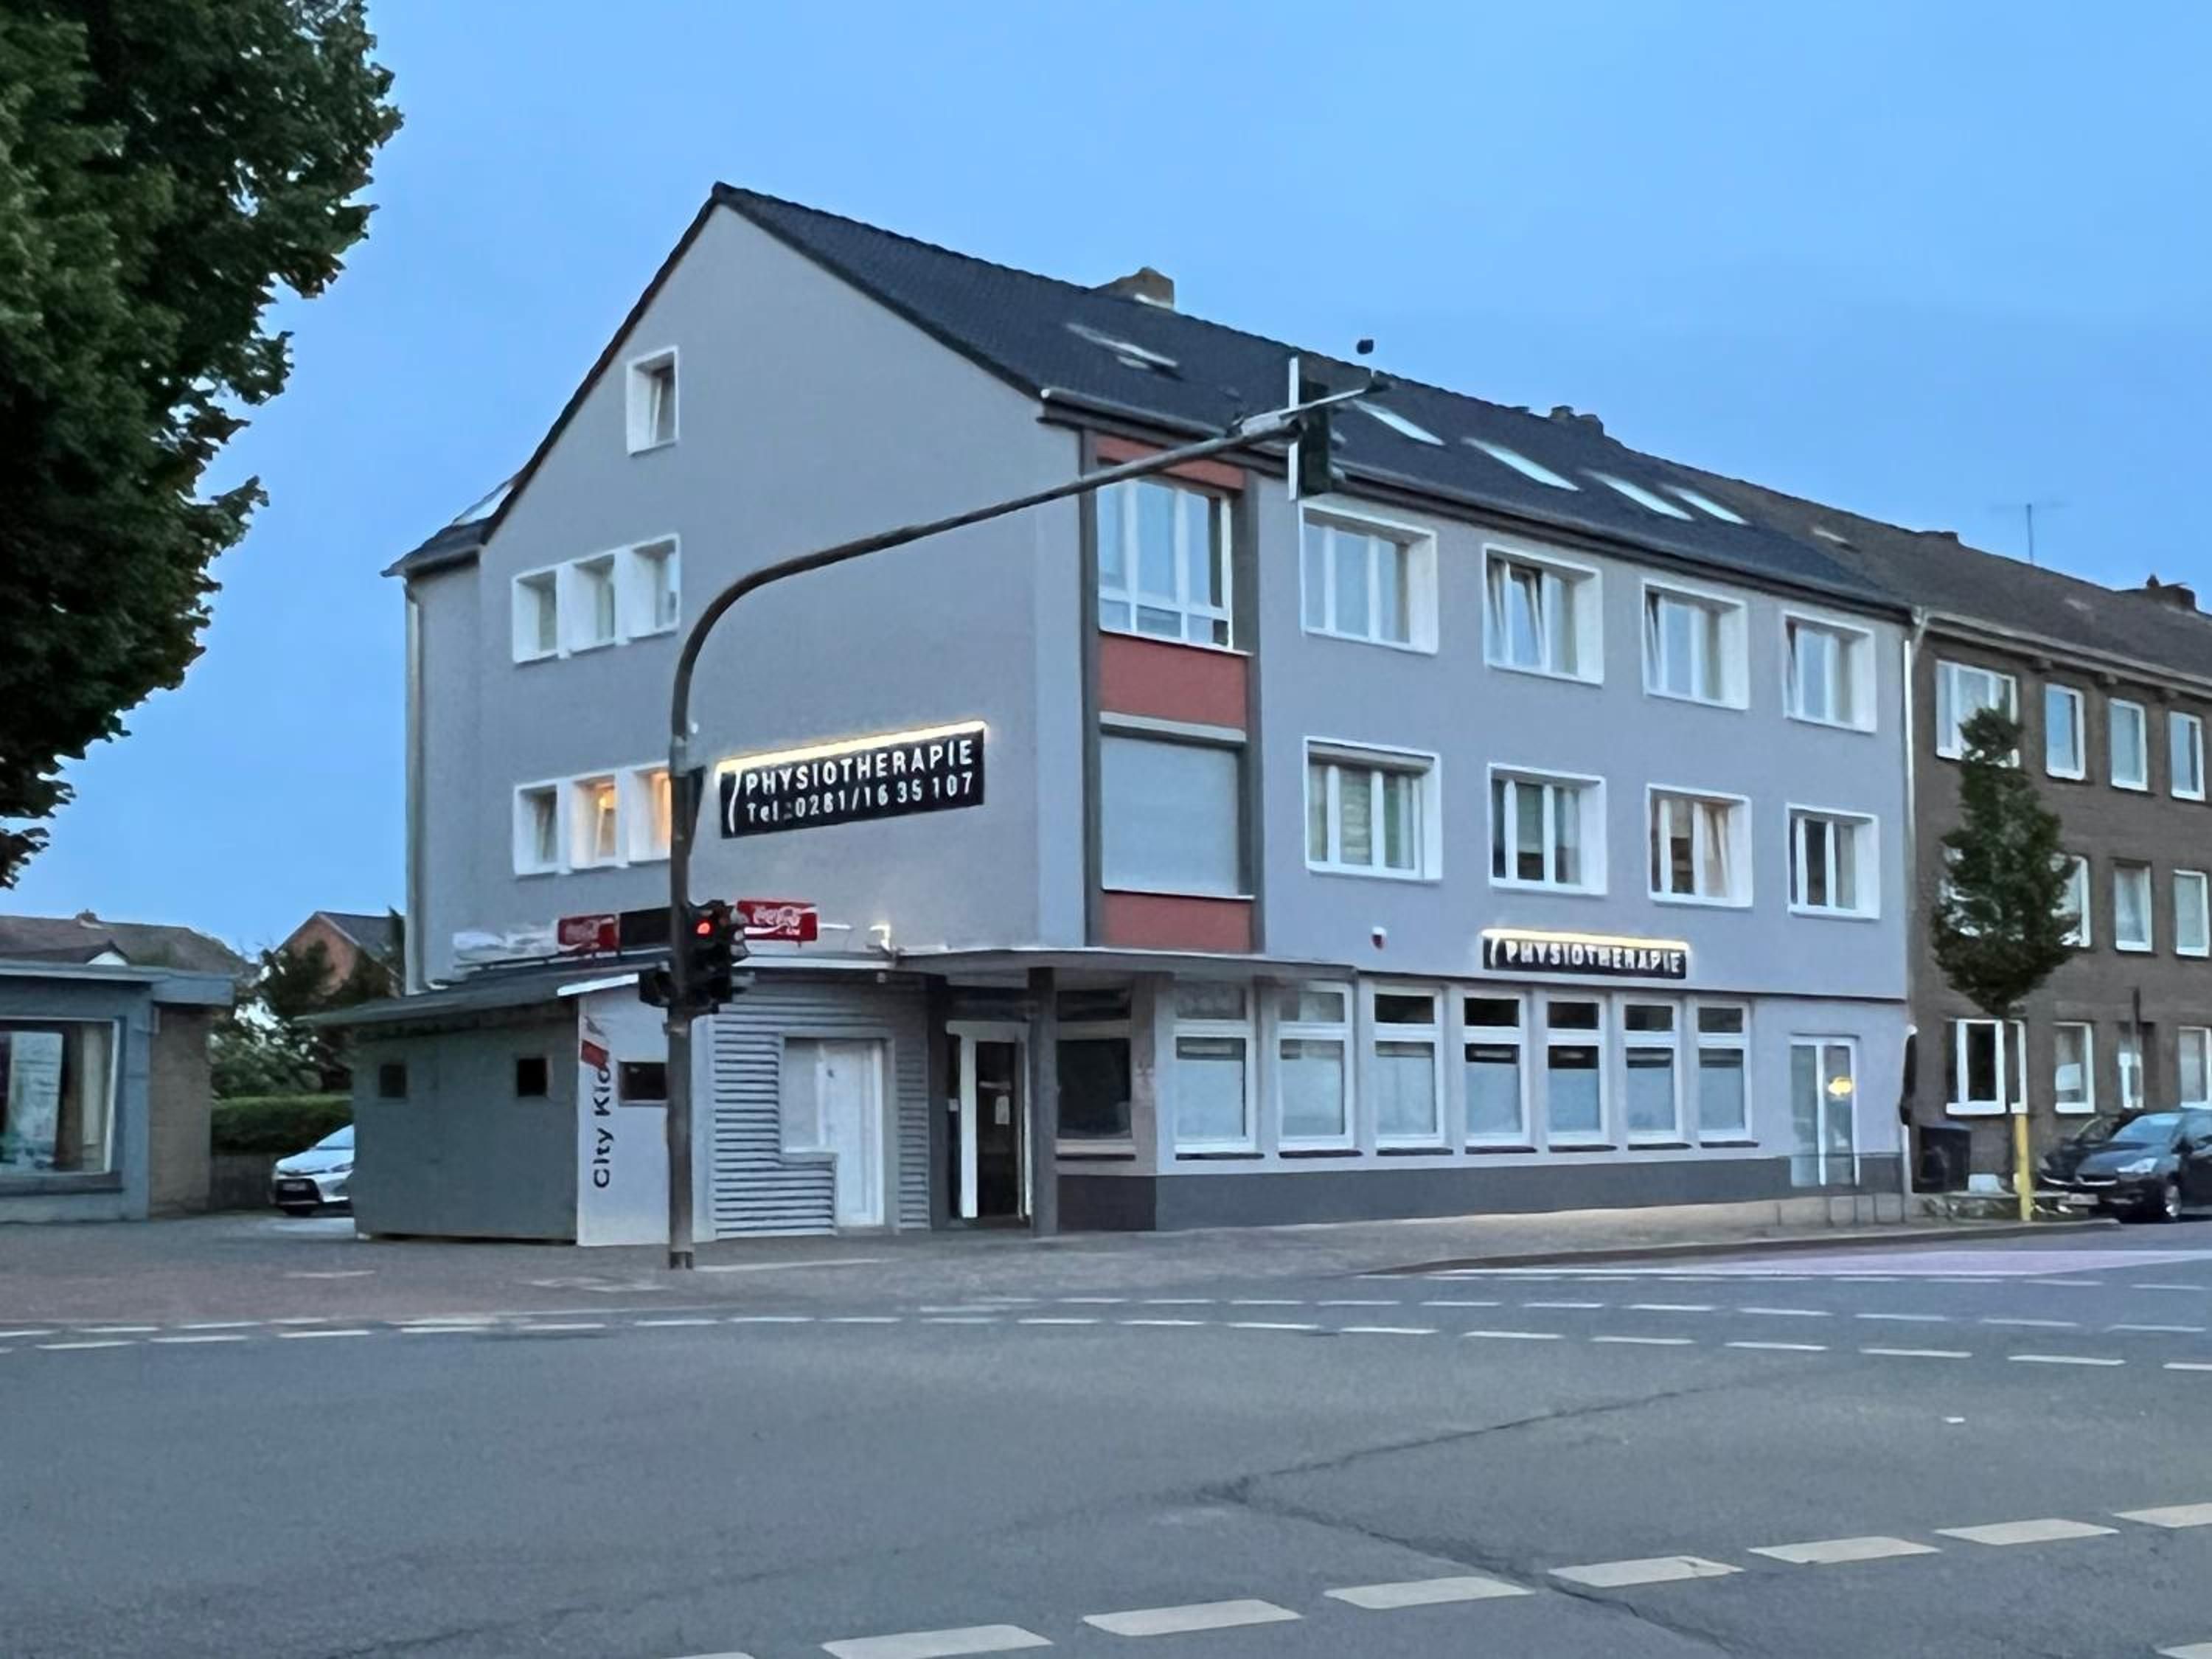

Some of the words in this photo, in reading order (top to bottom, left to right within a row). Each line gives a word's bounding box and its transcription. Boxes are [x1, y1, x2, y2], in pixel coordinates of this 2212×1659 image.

[745, 740, 973, 796] PHYSIOTHERAPIE
[932, 771, 973, 799] 107
[1505, 940, 1680, 973] PHYSIOTHERAPIE
[593, 1064, 611, 1116] Kio
[593, 1127, 614, 1188] City
